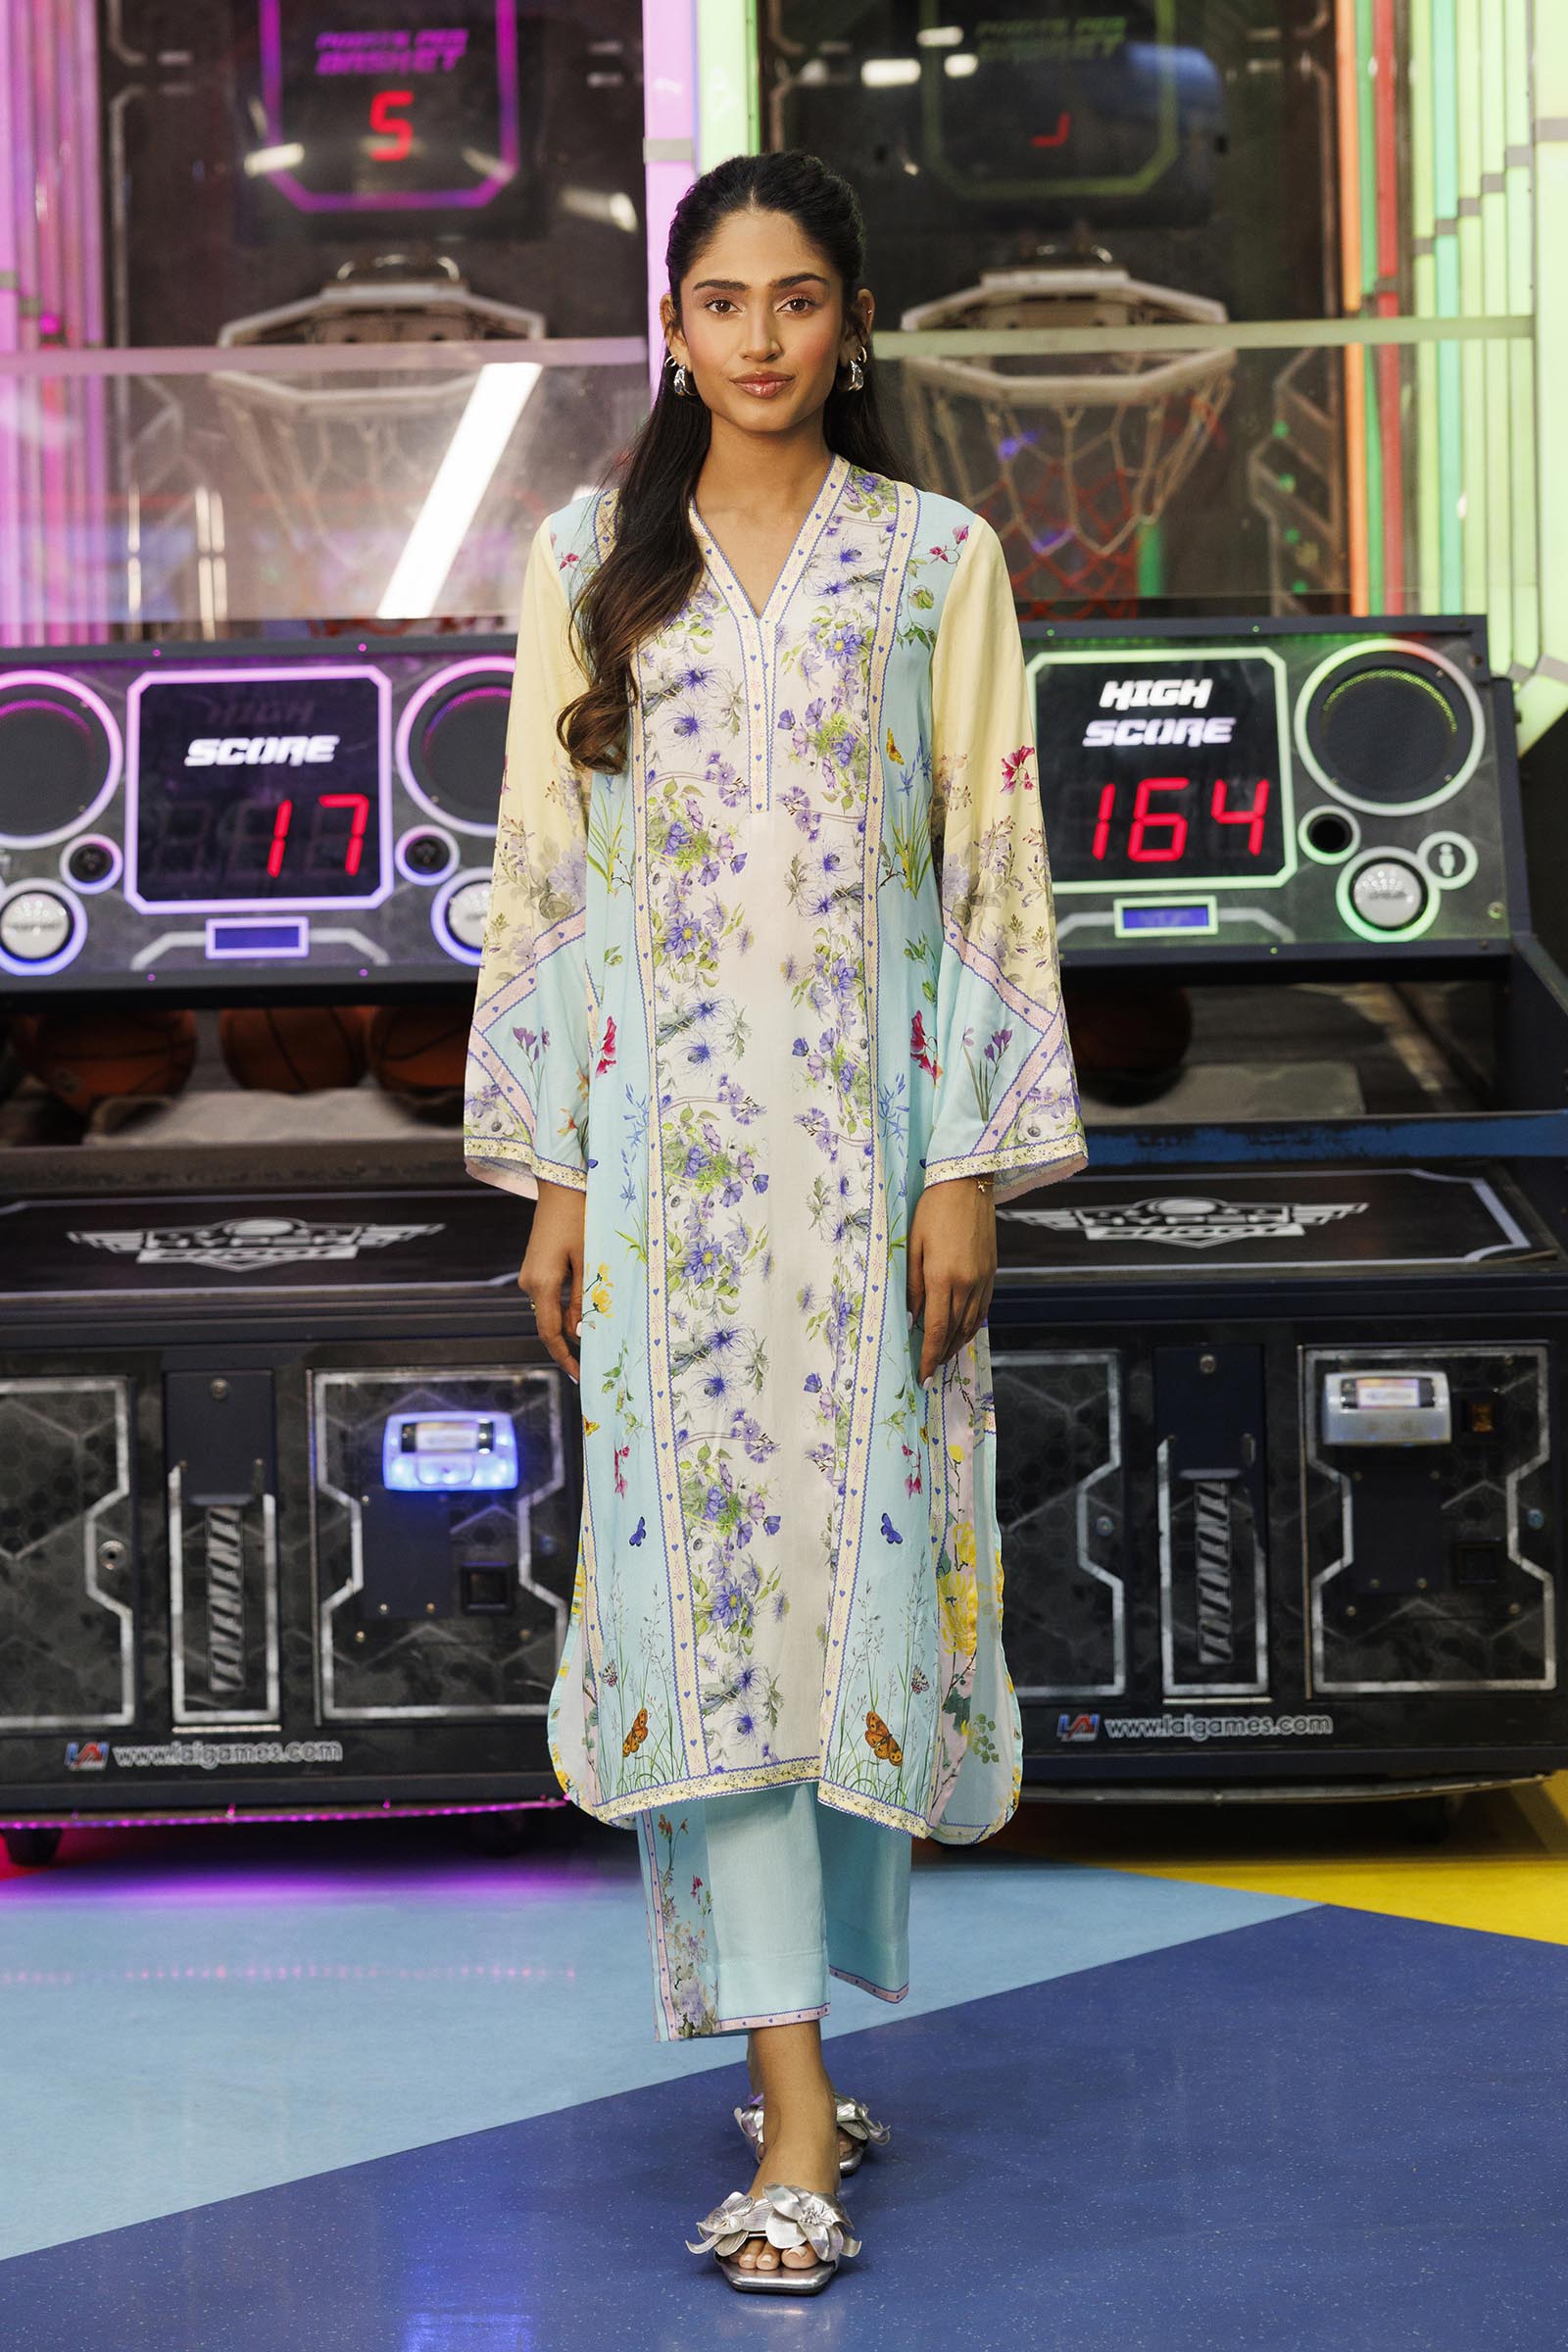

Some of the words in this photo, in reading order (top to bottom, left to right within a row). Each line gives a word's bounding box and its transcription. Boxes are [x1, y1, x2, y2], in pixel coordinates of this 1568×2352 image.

[368, 90, 416, 162] 5
[1099, 678, 1213, 710] HIGH
[1082, 717, 1237, 747] SCORE
[183, 735, 341, 766] SCORE
[1092, 777, 1269, 862] 164
[267, 794, 369, 877] 17
[1103, 1713, 1334, 1742] www.laigames.com
[112, 1740, 343, 1770] www.laigames.com
